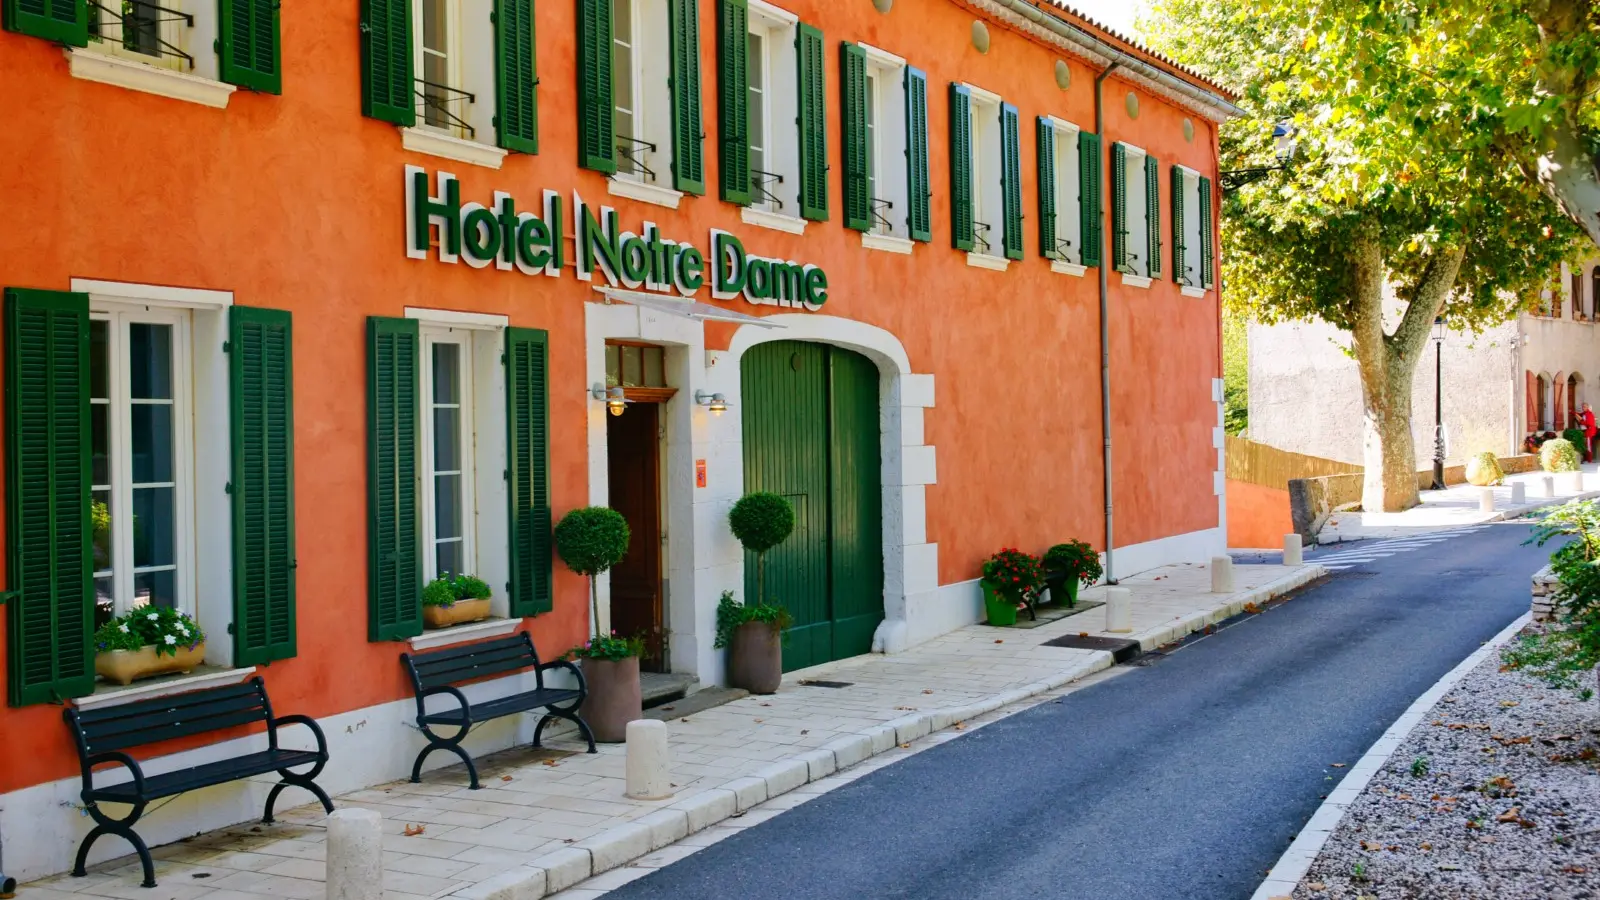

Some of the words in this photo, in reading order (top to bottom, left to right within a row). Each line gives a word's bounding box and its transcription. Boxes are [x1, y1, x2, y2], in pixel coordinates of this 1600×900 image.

[410, 170, 563, 270] Hotel
[578, 196, 705, 290] Notre
[714, 231, 828, 307] Dame
